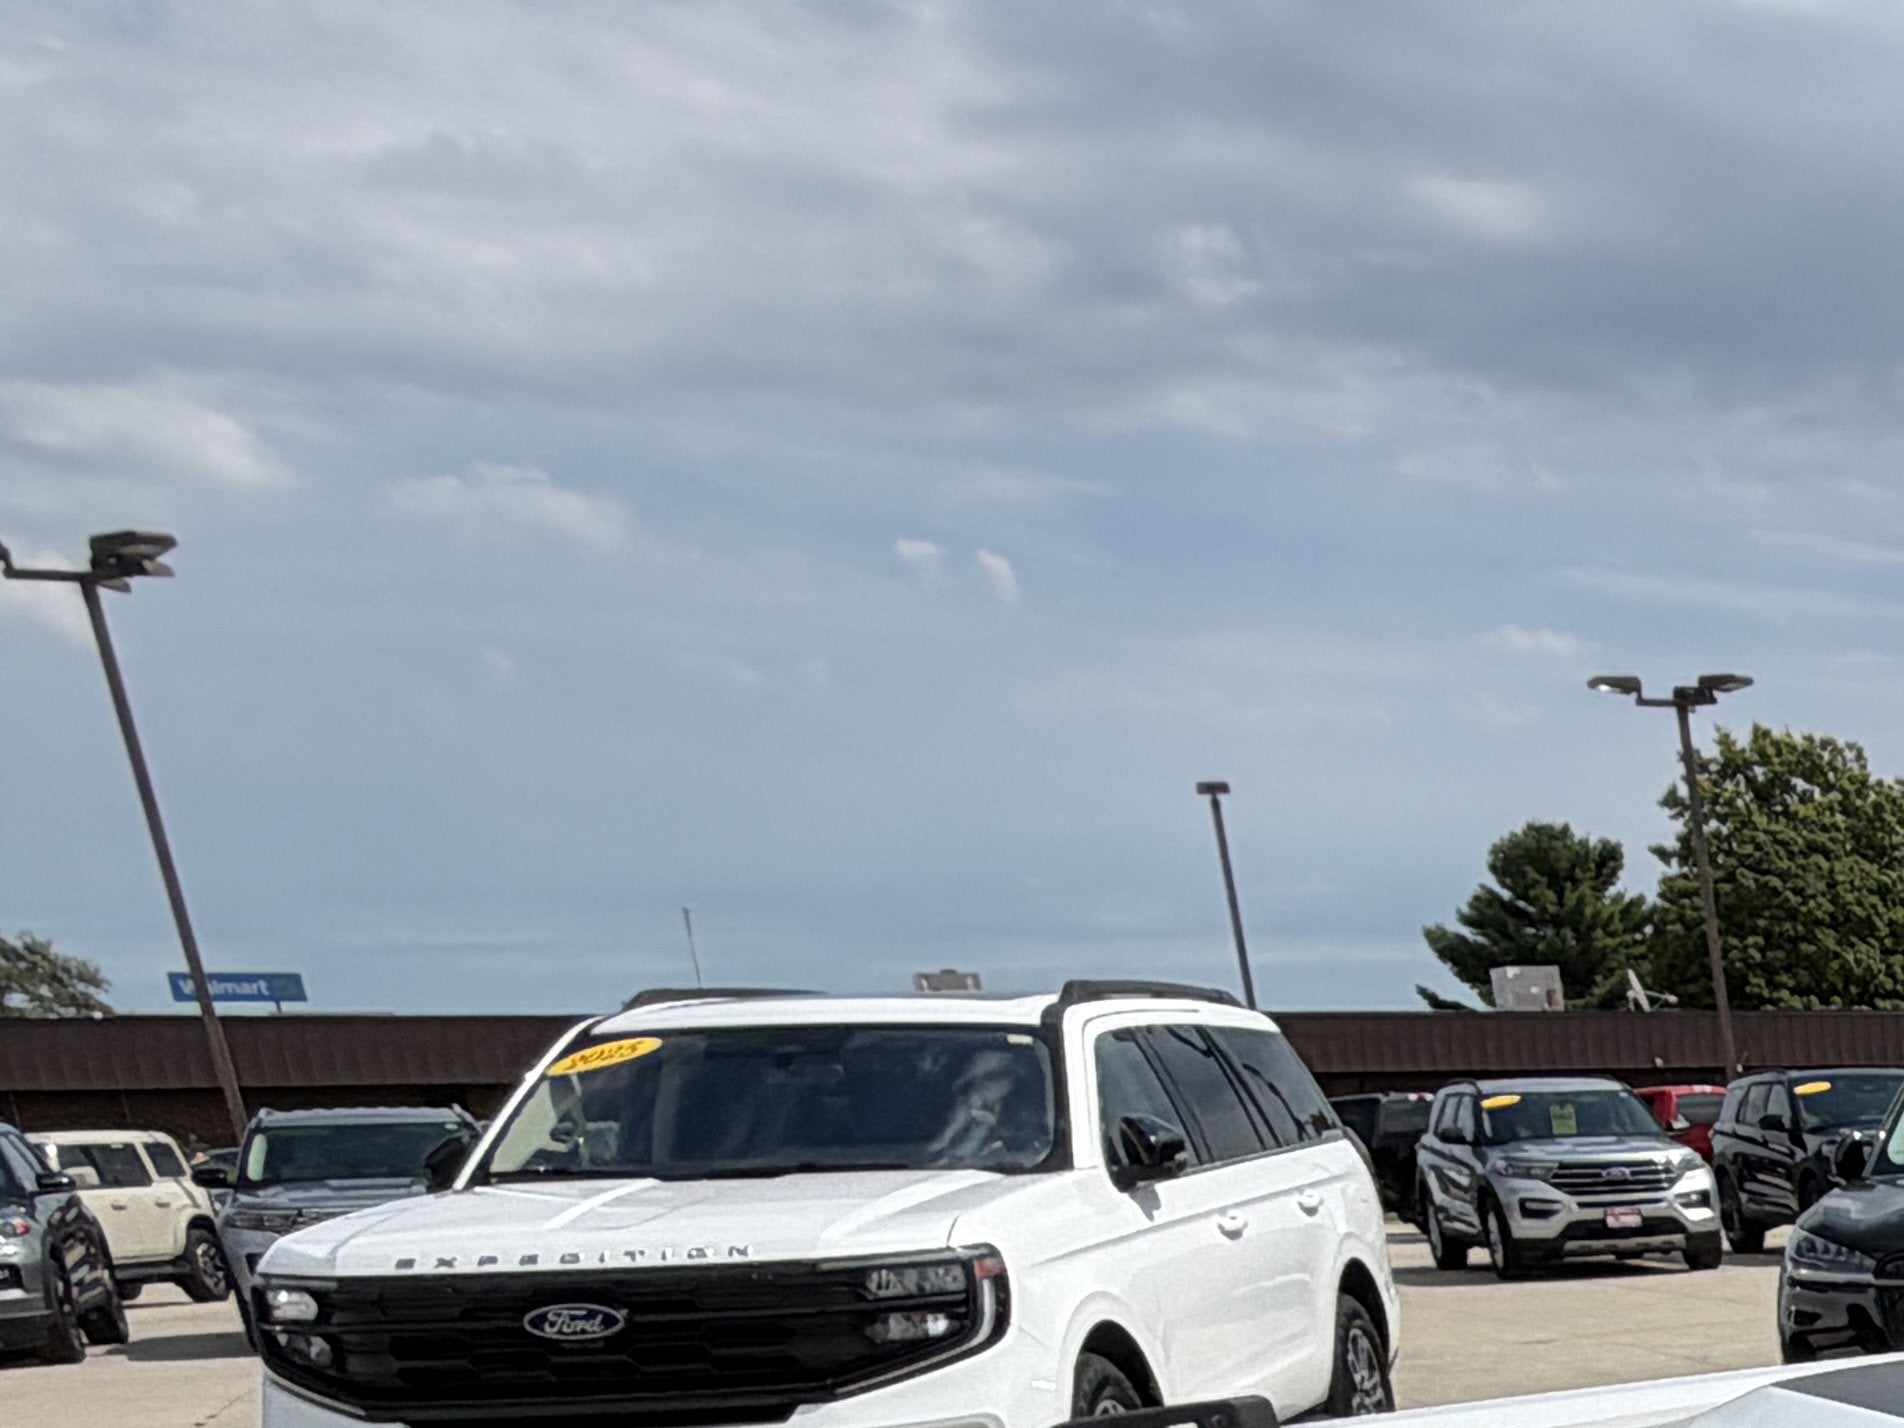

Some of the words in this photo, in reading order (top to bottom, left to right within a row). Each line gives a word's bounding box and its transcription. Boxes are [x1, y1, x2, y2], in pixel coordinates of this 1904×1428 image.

[177, 979, 270, 996] Wlmart
[394, 1244, 754, 1271] EXPEDITION
[543, 1309, 604, 1336] Ford
